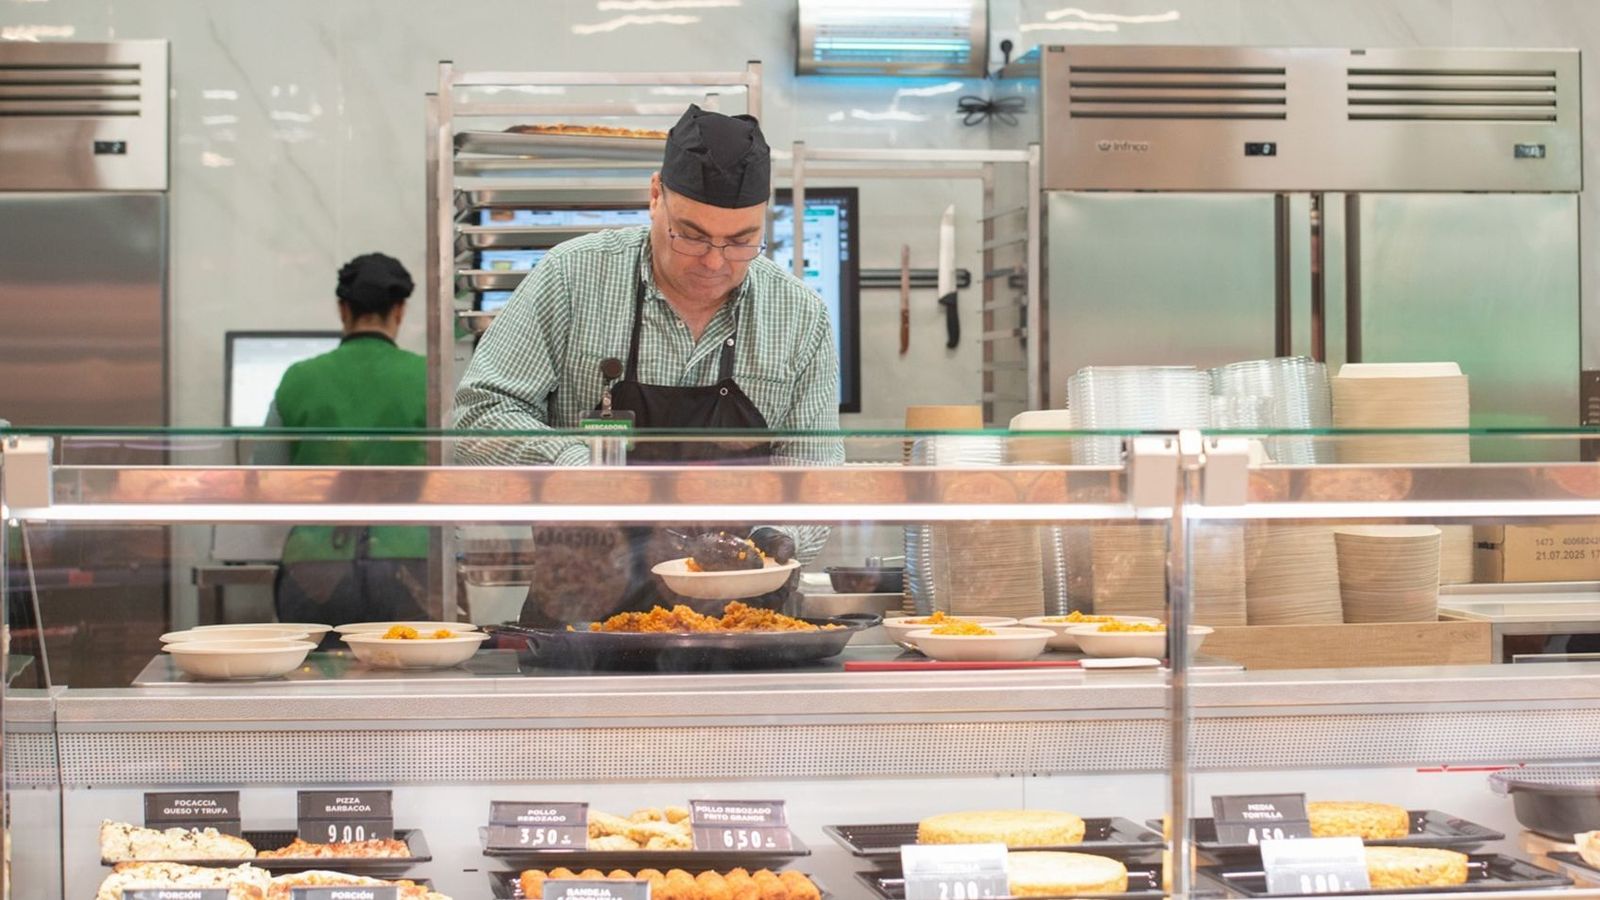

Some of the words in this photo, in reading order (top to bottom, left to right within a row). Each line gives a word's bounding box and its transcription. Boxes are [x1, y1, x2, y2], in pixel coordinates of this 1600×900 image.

[1535, 551, 1585, 560] 21.07.2025
[163, 807, 192, 815] QUESO
[695, 805, 724, 813] POLLO
[725, 807, 772, 815] REBOZADO
[730, 814, 765, 822] GRANDE
[520, 828, 557, 846] 3,50
[723, 829, 761, 850] 6,50
[158, 891, 202, 899] PORCIÓN
[330, 890, 374, 899] PORCIÓN
[566, 887, 611, 896] BANDEJA
